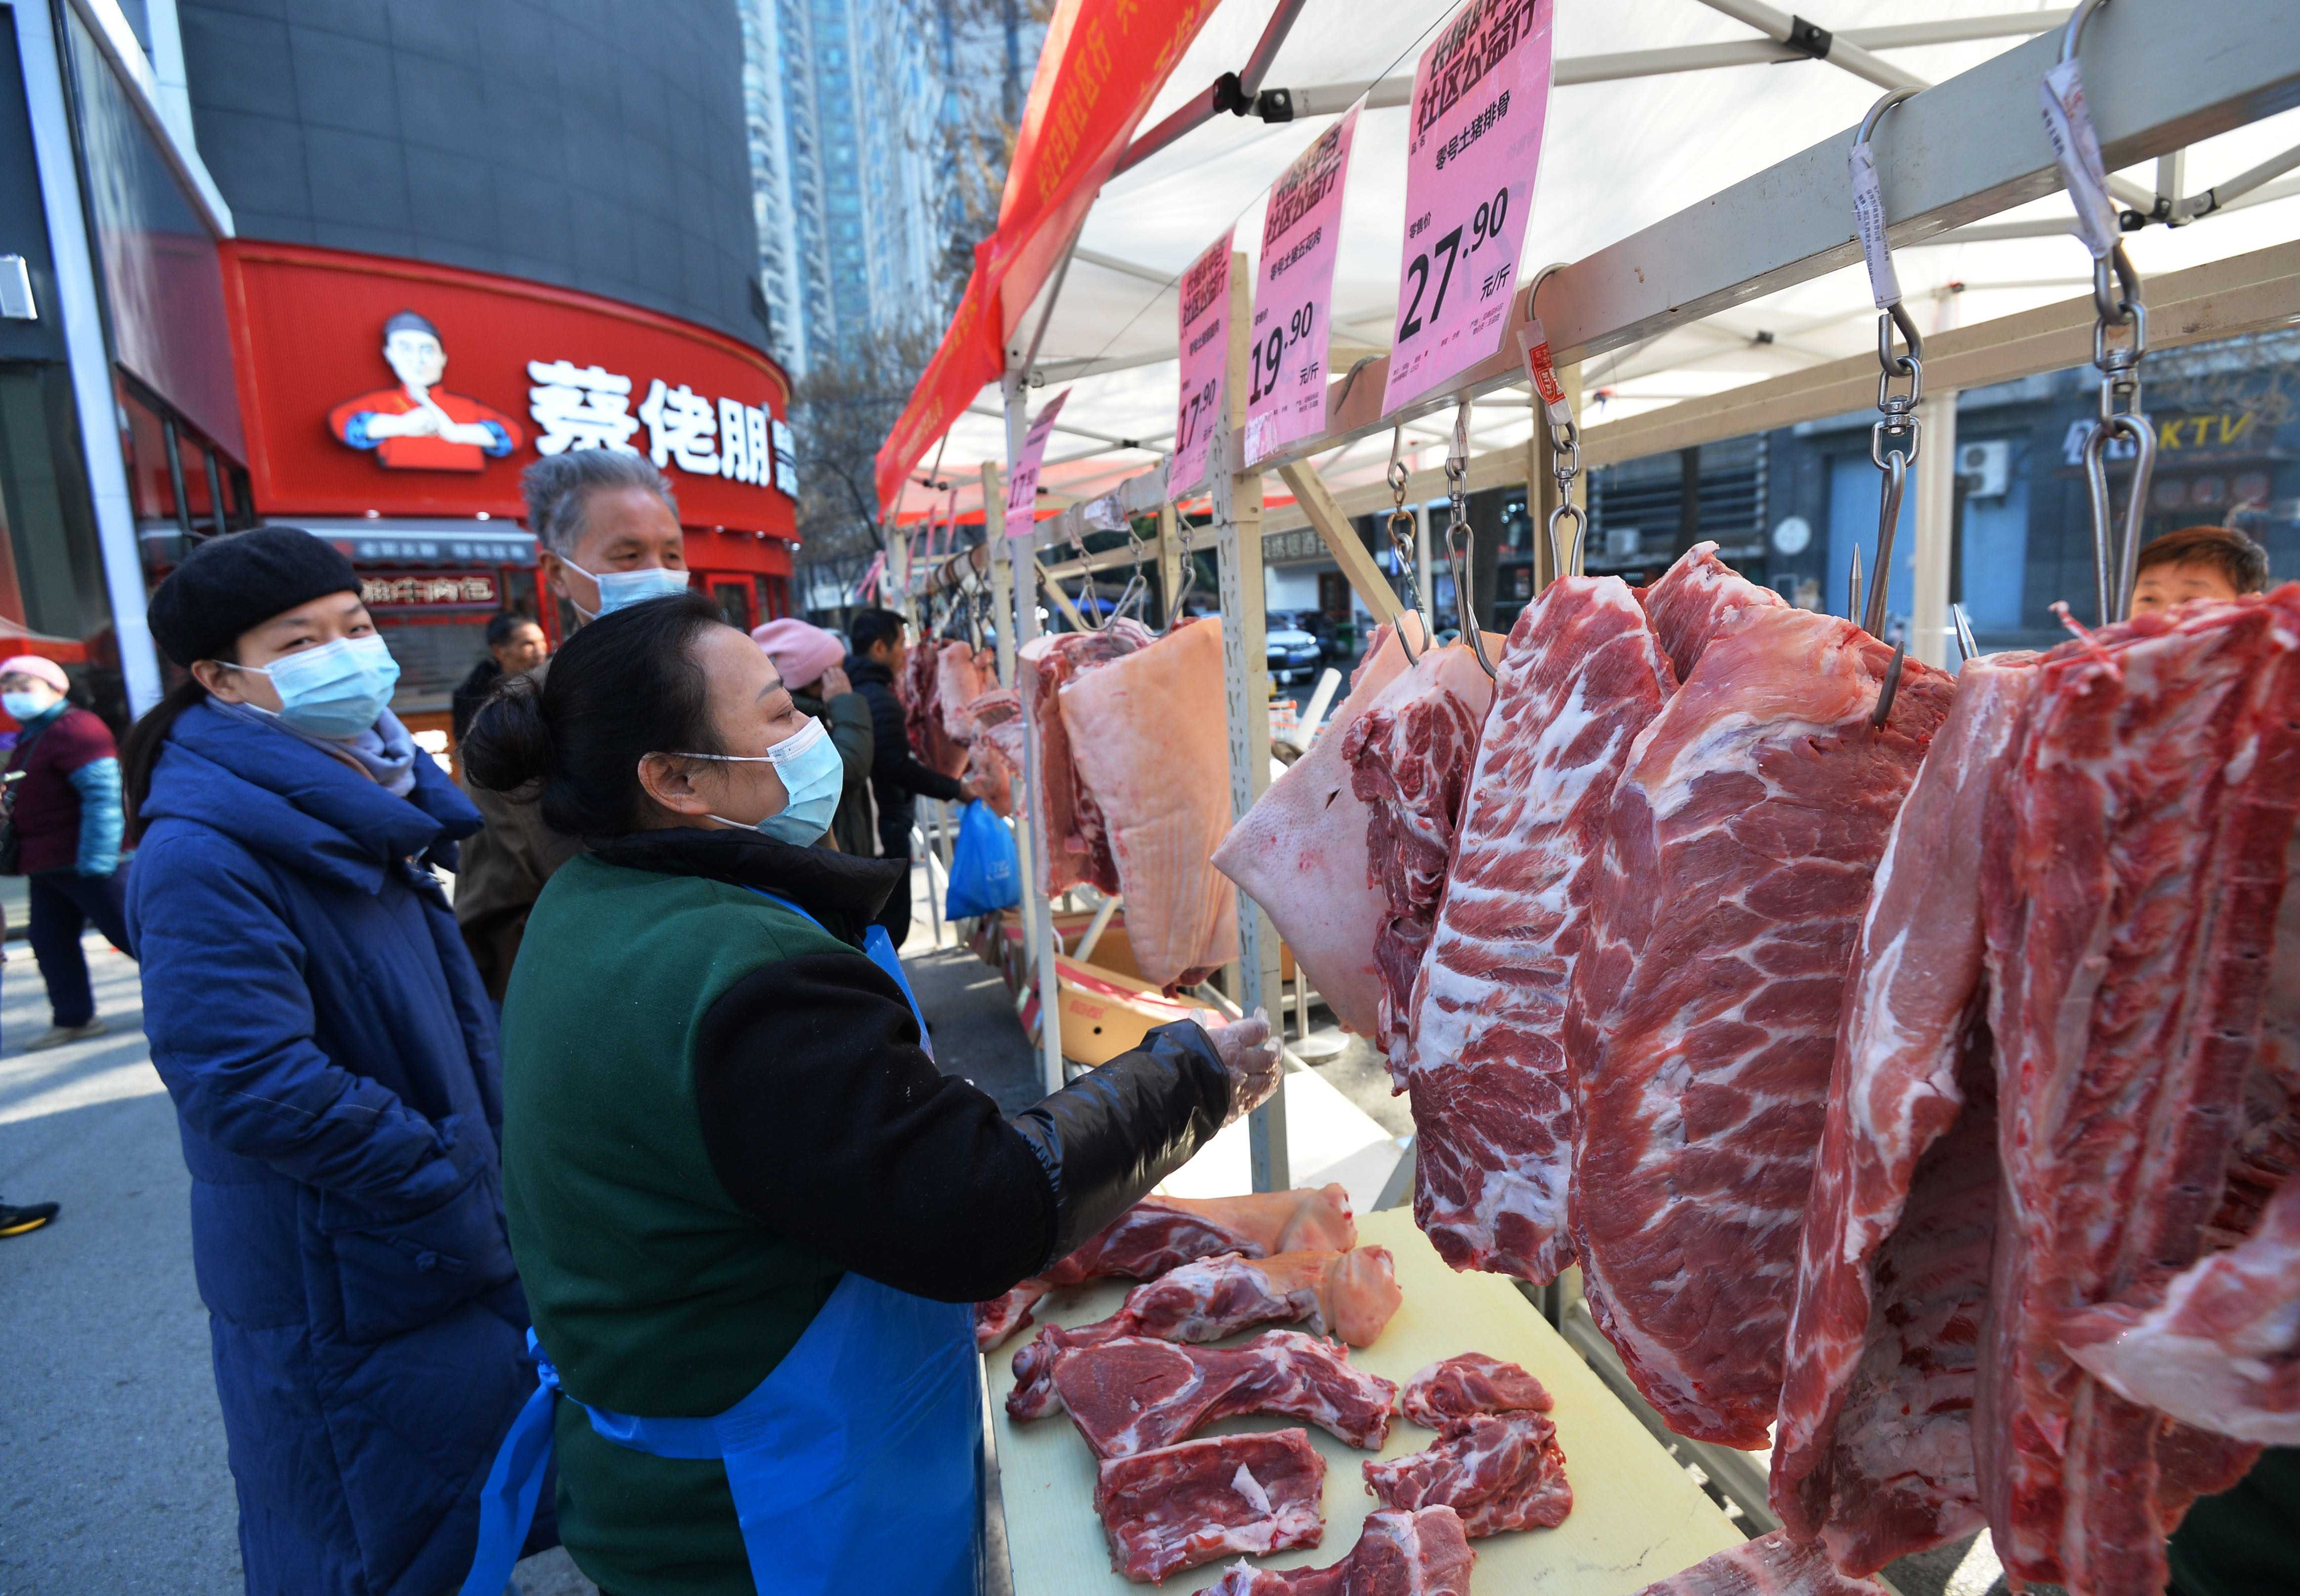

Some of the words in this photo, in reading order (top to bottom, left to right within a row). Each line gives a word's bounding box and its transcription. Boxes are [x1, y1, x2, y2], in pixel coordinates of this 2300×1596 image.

[1417, 0, 1535, 136] 社区公益行
[1436, 89, 1510, 170] 零号土猪排骨
[1266, 148, 1343, 248] 社区公益行
[1410, 211, 1431, 238] 零售价
[1399, 187, 1508, 344] 27.90
[1480, 263, 1511, 302] 元/斤
[1249, 301, 1313, 406] 19.90
[1299, 361, 1319, 386] 元/斤
[527, 360, 770, 487] 蔡佬朋
[1177, 378, 1216, 455] 17.90
[2158, 411, 2255, 451] KTV
